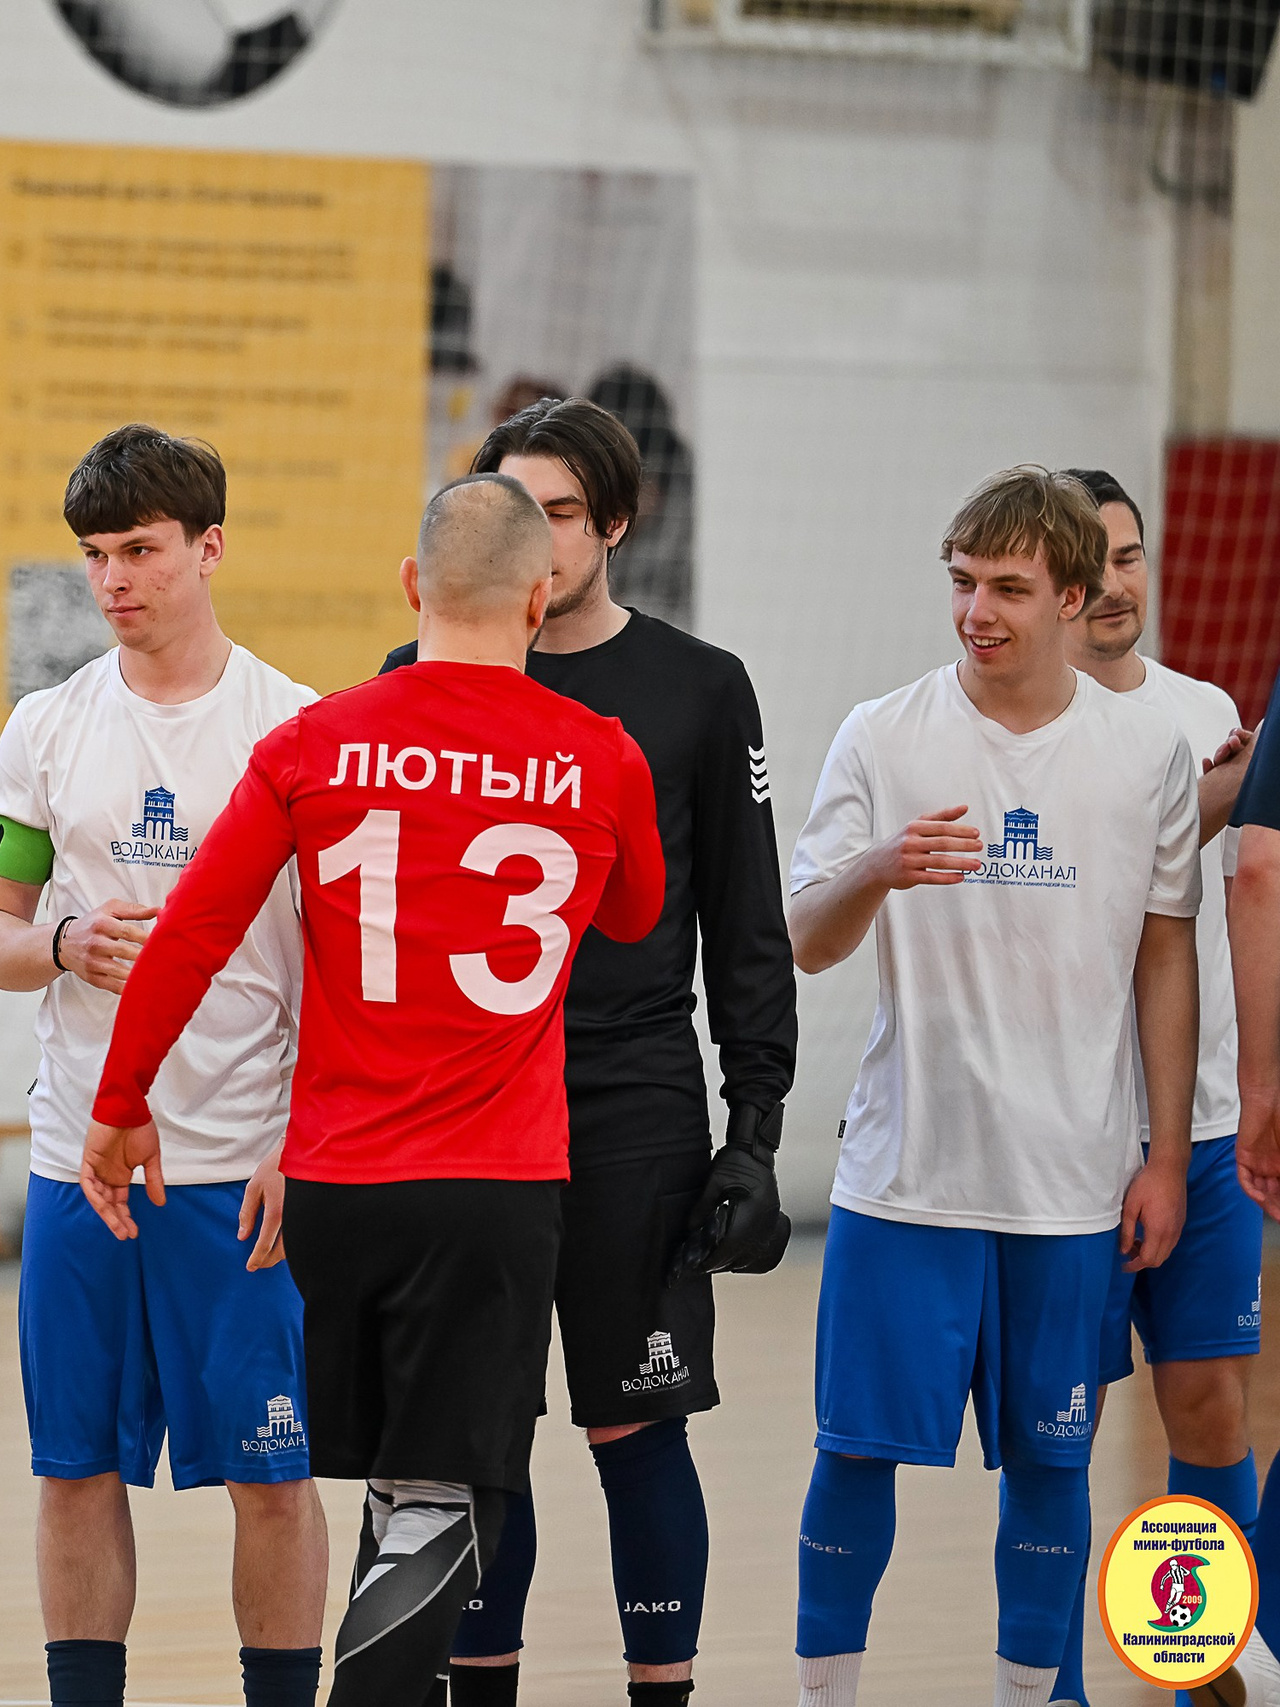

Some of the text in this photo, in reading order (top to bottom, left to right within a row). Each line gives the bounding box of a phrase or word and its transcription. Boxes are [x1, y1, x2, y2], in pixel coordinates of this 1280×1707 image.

[328, 743, 582, 809] ЛЮТЫЙ
[110, 841, 199, 861] ВОДОКАНА
[318, 809, 578, 1015] 13
[241, 1433, 306, 1454] ВОДОКАН
[624, 1600, 681, 1613] JAKO
